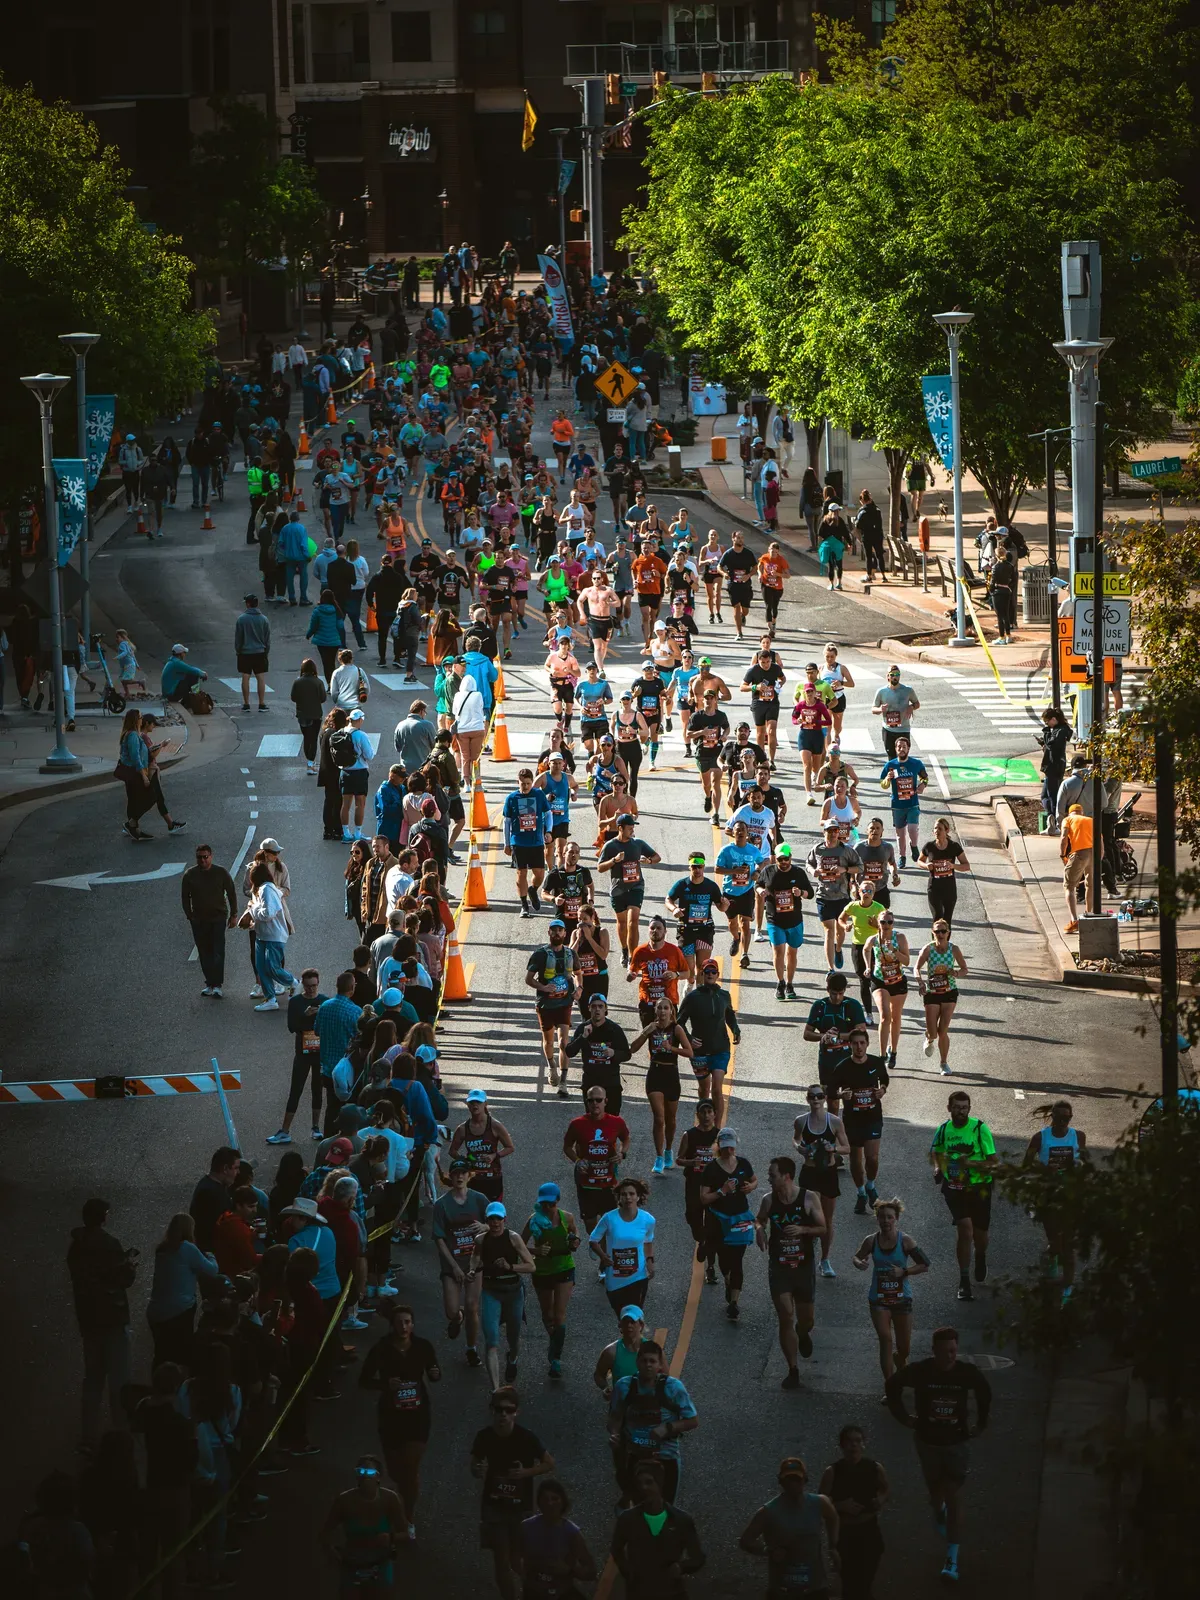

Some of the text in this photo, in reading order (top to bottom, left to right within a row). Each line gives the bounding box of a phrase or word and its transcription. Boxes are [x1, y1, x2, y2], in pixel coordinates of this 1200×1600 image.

[552, 294, 571, 335] RUMBLE
[939, 392, 949, 455] GULCH
[87, 411, 98, 475] GULCH
[1134, 461, 1168, 477] LAUREL
[60, 477, 73, 549] GULCH
[1106, 629, 1122, 638] USE
[1104, 643, 1127, 652] LANE
[648, 962, 668, 971] NASH
[397, 1388, 417, 1397] 2298
[633, 1437, 657, 1446] 20815
[497, 1483, 517, 1492] 4717
